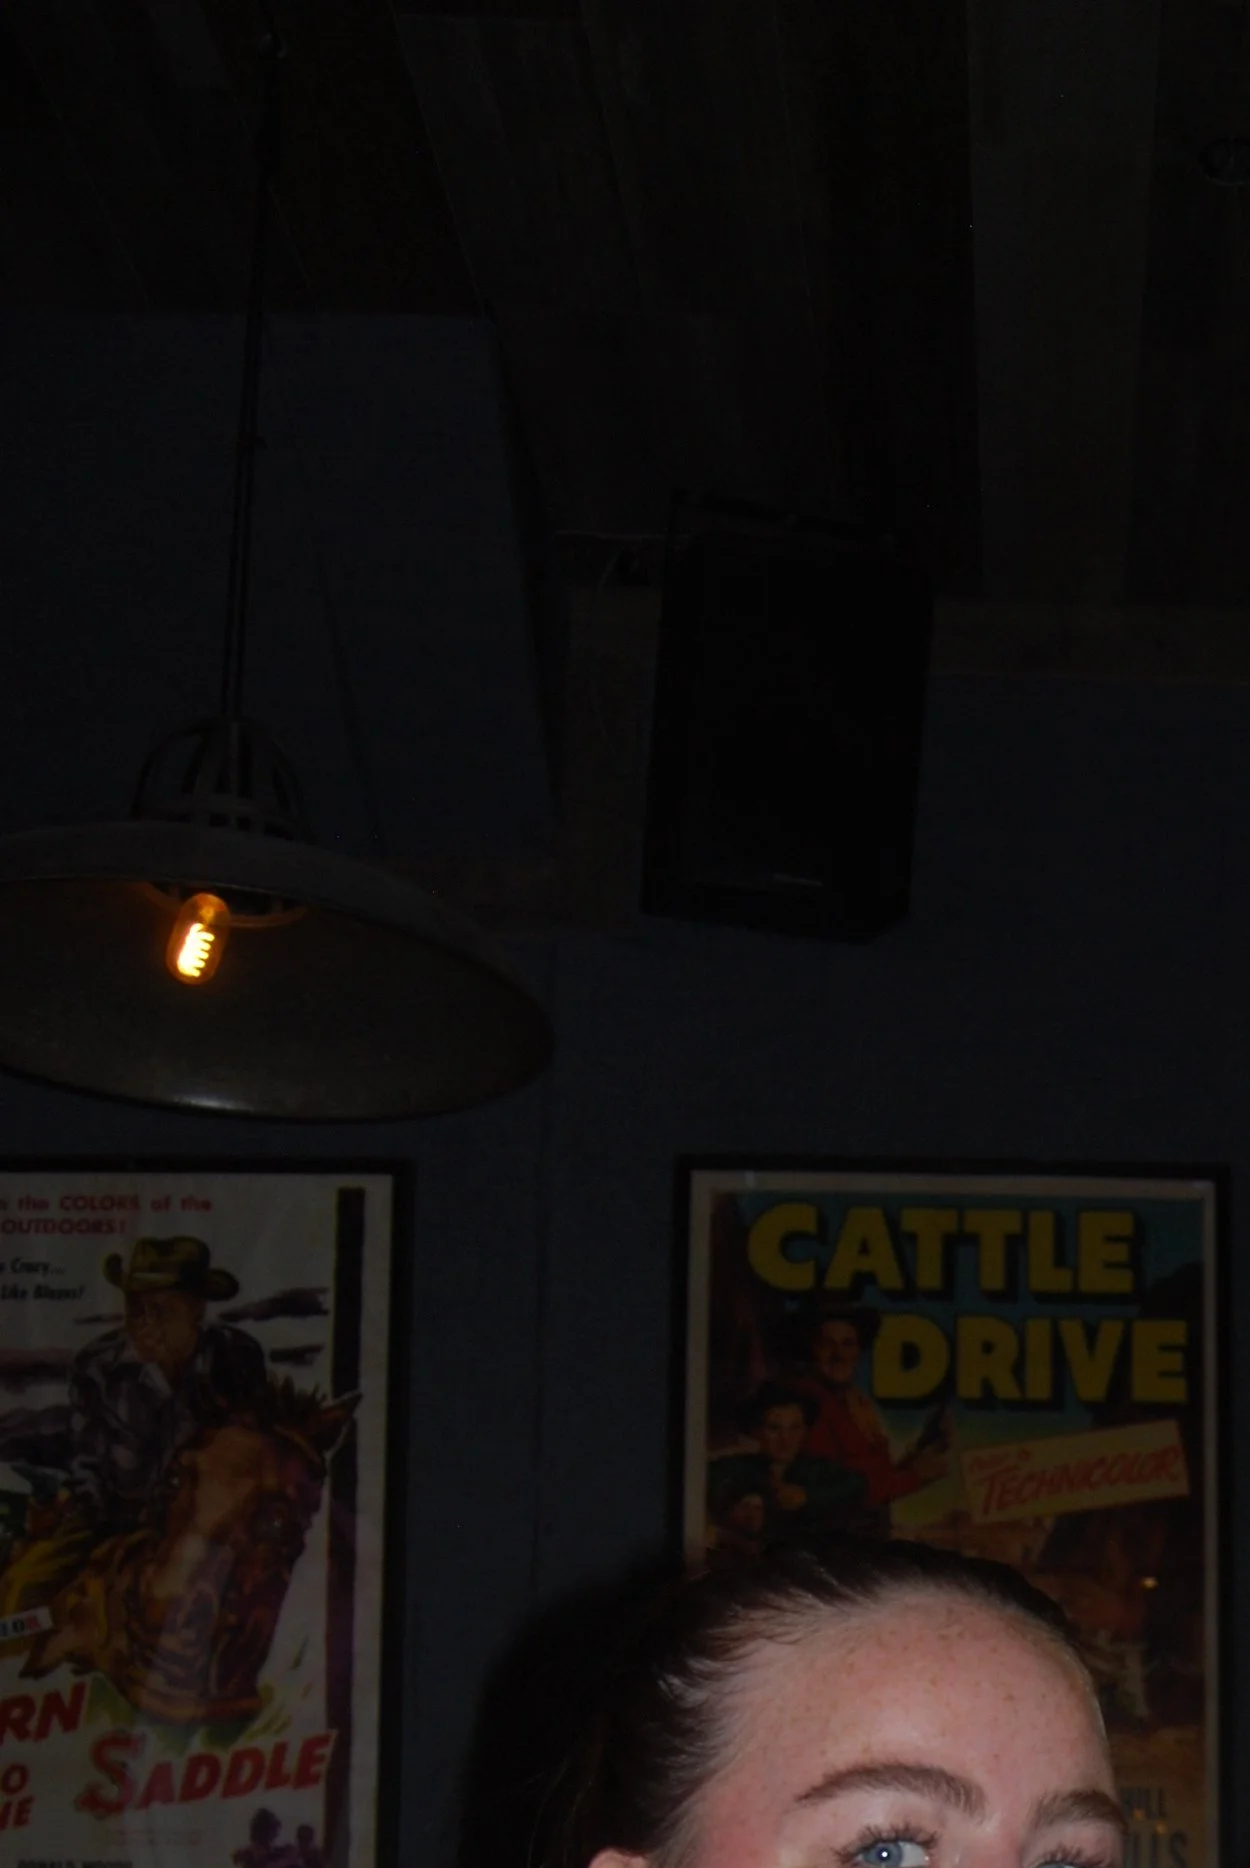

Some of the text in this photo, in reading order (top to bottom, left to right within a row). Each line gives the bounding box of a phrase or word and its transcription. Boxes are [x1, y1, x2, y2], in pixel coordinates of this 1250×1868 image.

[747, 1201, 1135, 1294] CATTLE
[872, 1313, 1189, 1404] DRIVE
[77, 1731, 333, 1817] SADDLE
